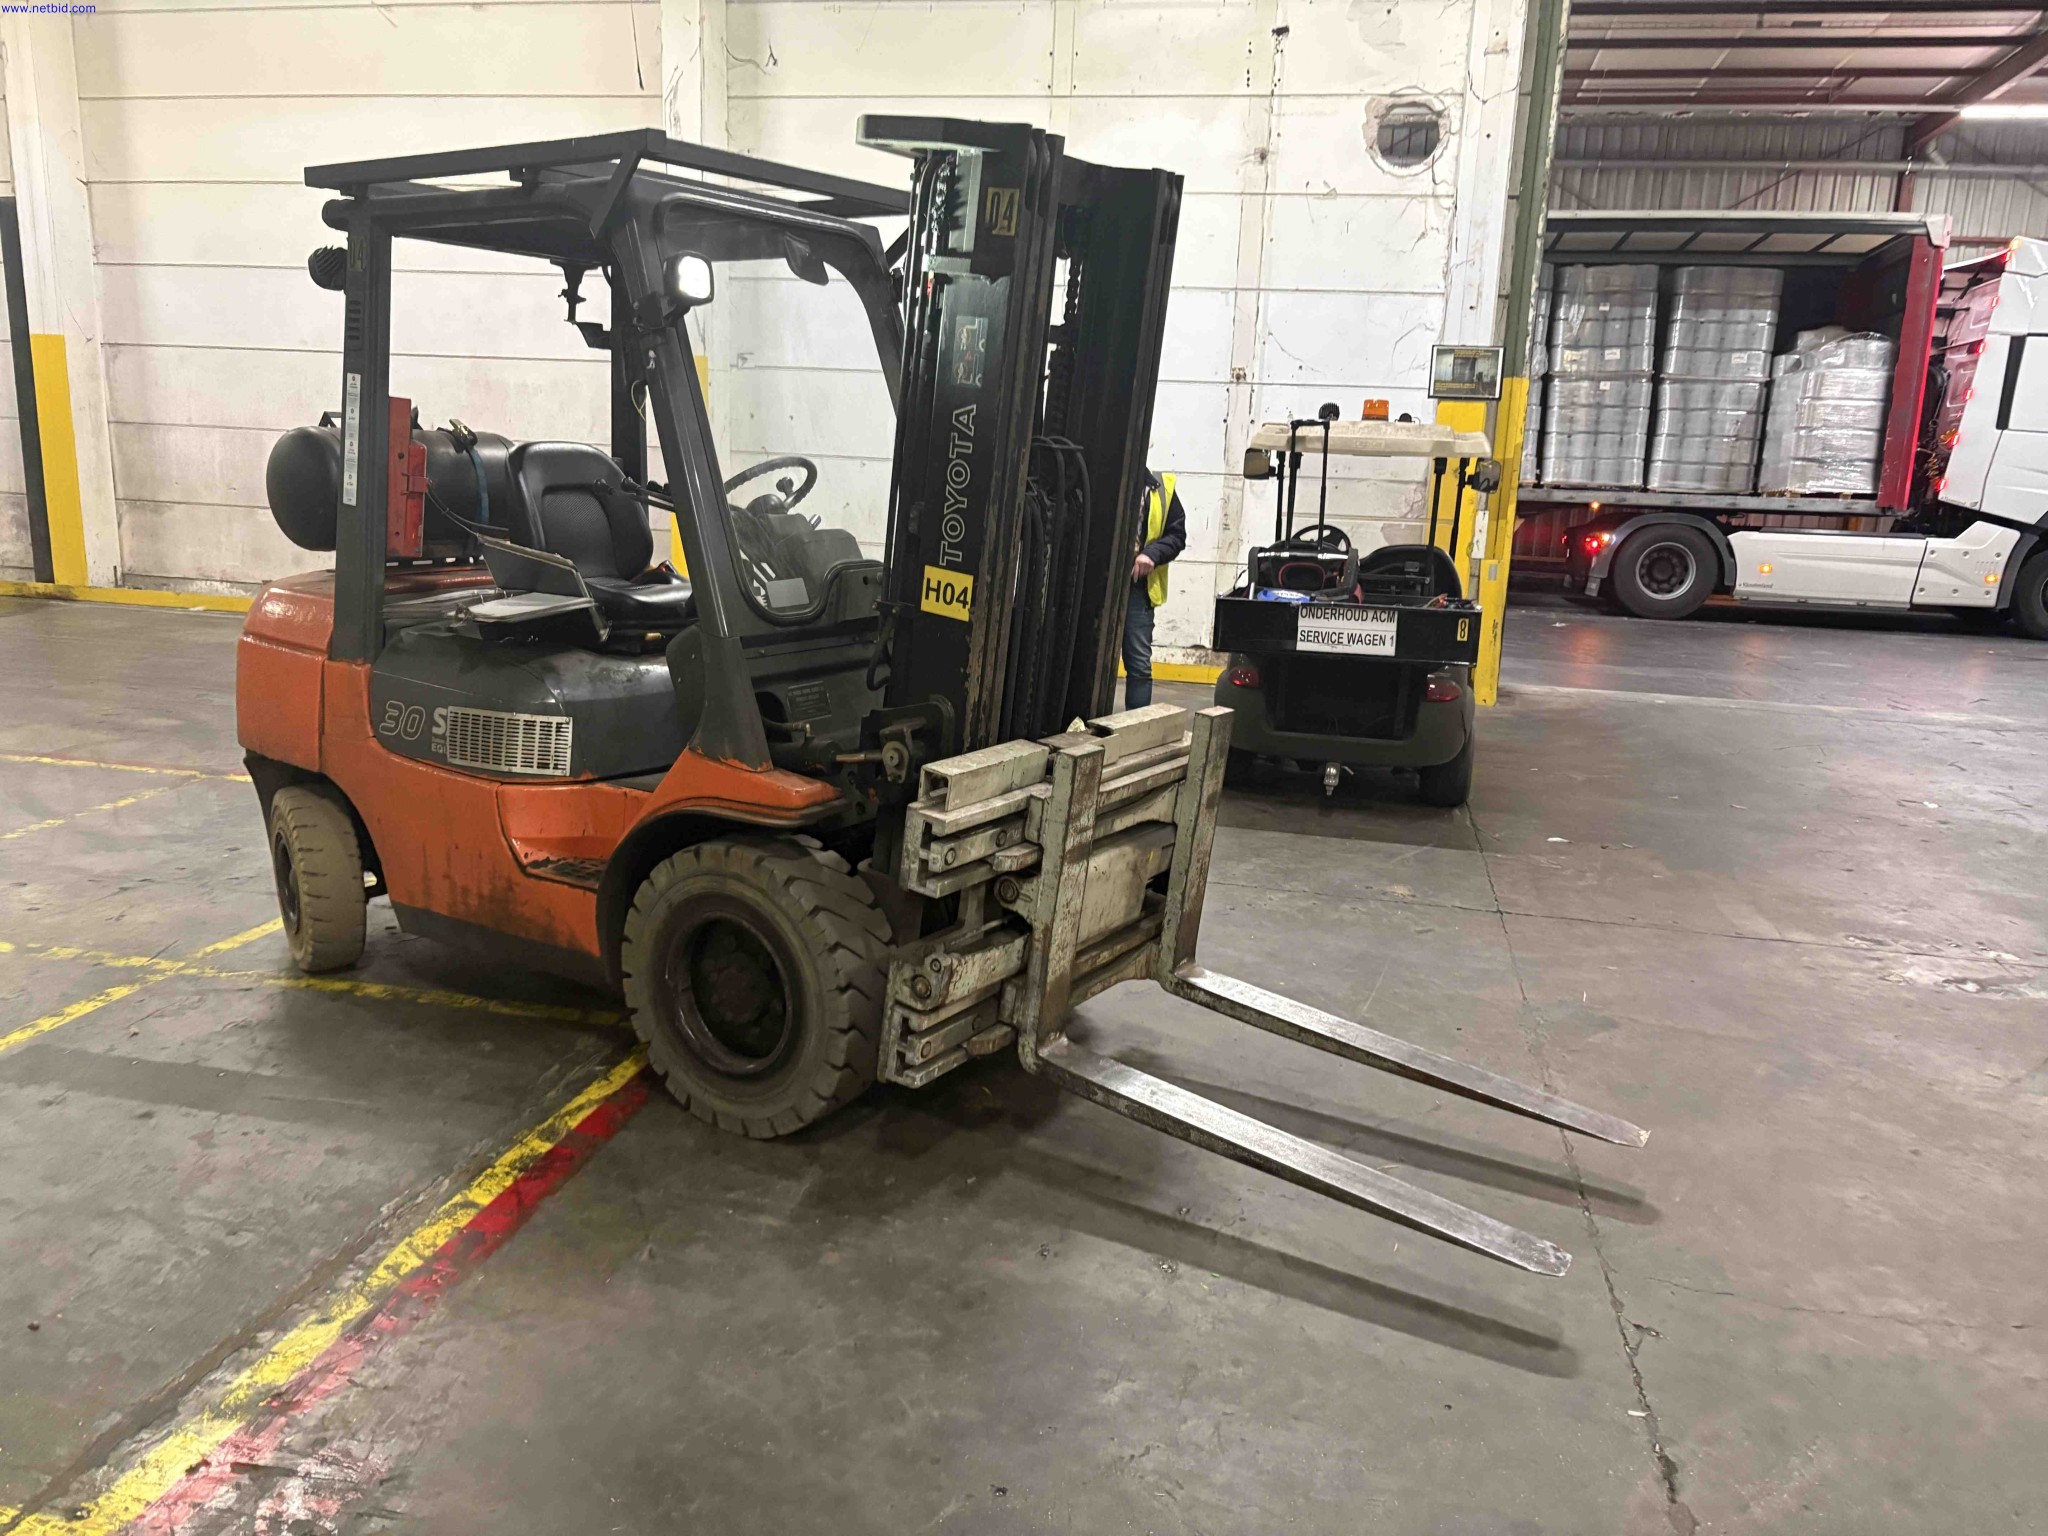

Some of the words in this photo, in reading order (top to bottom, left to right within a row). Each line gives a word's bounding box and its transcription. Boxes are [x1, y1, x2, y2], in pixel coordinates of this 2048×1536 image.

[989, 191, 1014, 232] 04
[939, 404, 977, 566] TOYOTA
[924, 577, 969, 609] H04
[1300, 607, 1369, 622] ONDERHOUD
[1371, 610, 1396, 624] ACM
[1459, 619, 1467, 639] 8
[1299, 630, 1344, 644] SERVICE
[1347, 633, 1387, 647] WAGEN
[1389, 635, 1395, 648] 1
[379, 700, 426, 740] 30
[432, 707, 448, 736] S
